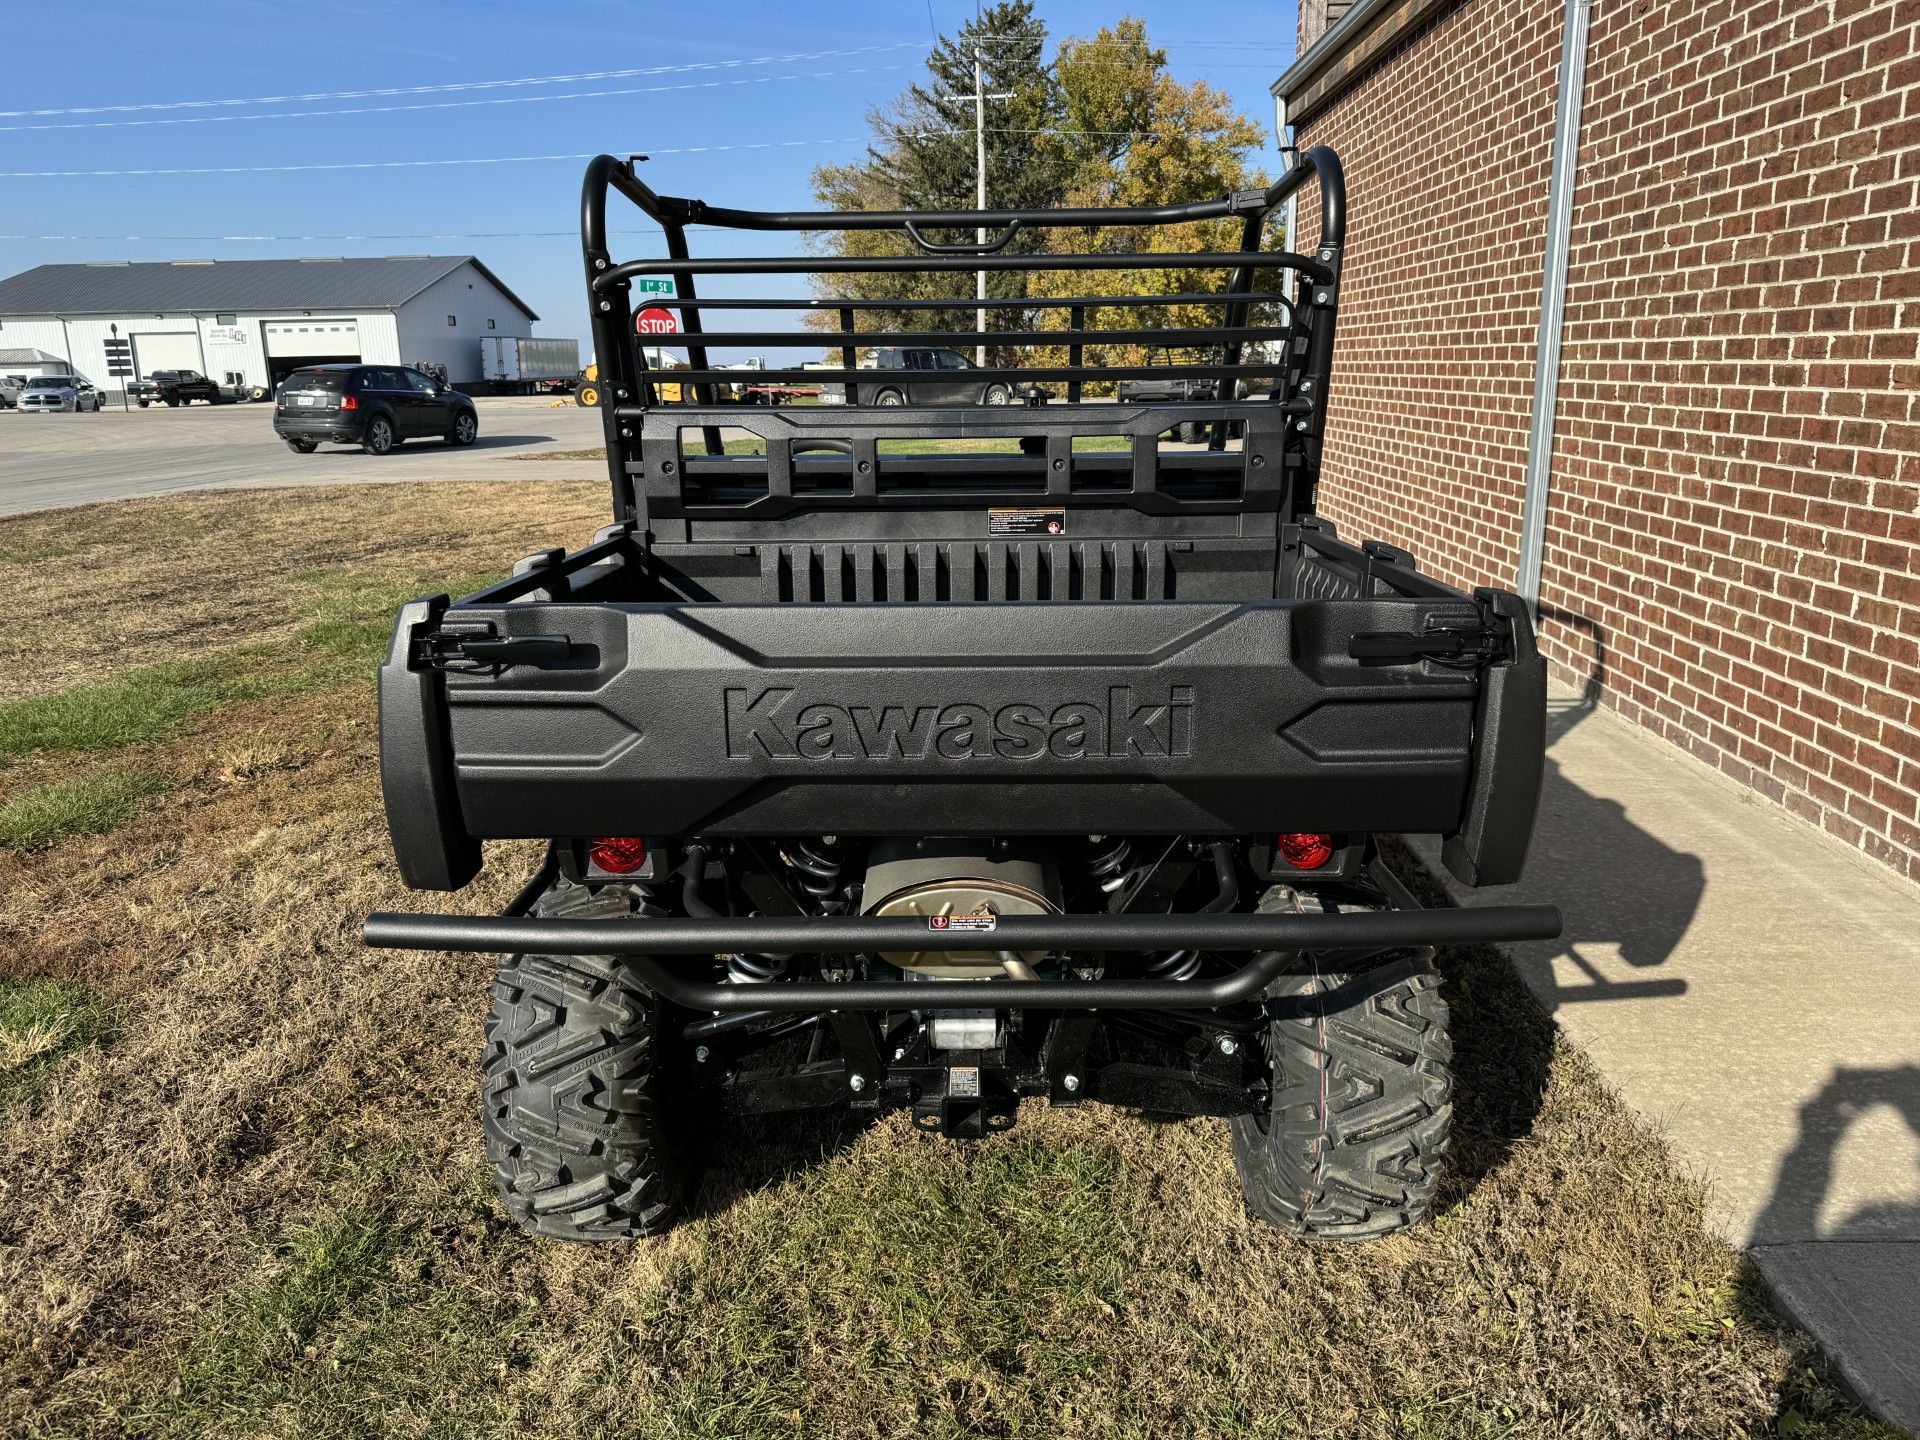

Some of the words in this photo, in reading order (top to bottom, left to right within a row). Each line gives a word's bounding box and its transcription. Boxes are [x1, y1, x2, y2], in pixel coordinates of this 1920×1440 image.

[658, 281, 668, 292] St
[640, 319, 675, 334] STOP
[723, 686, 1195, 761] Kawasaki
